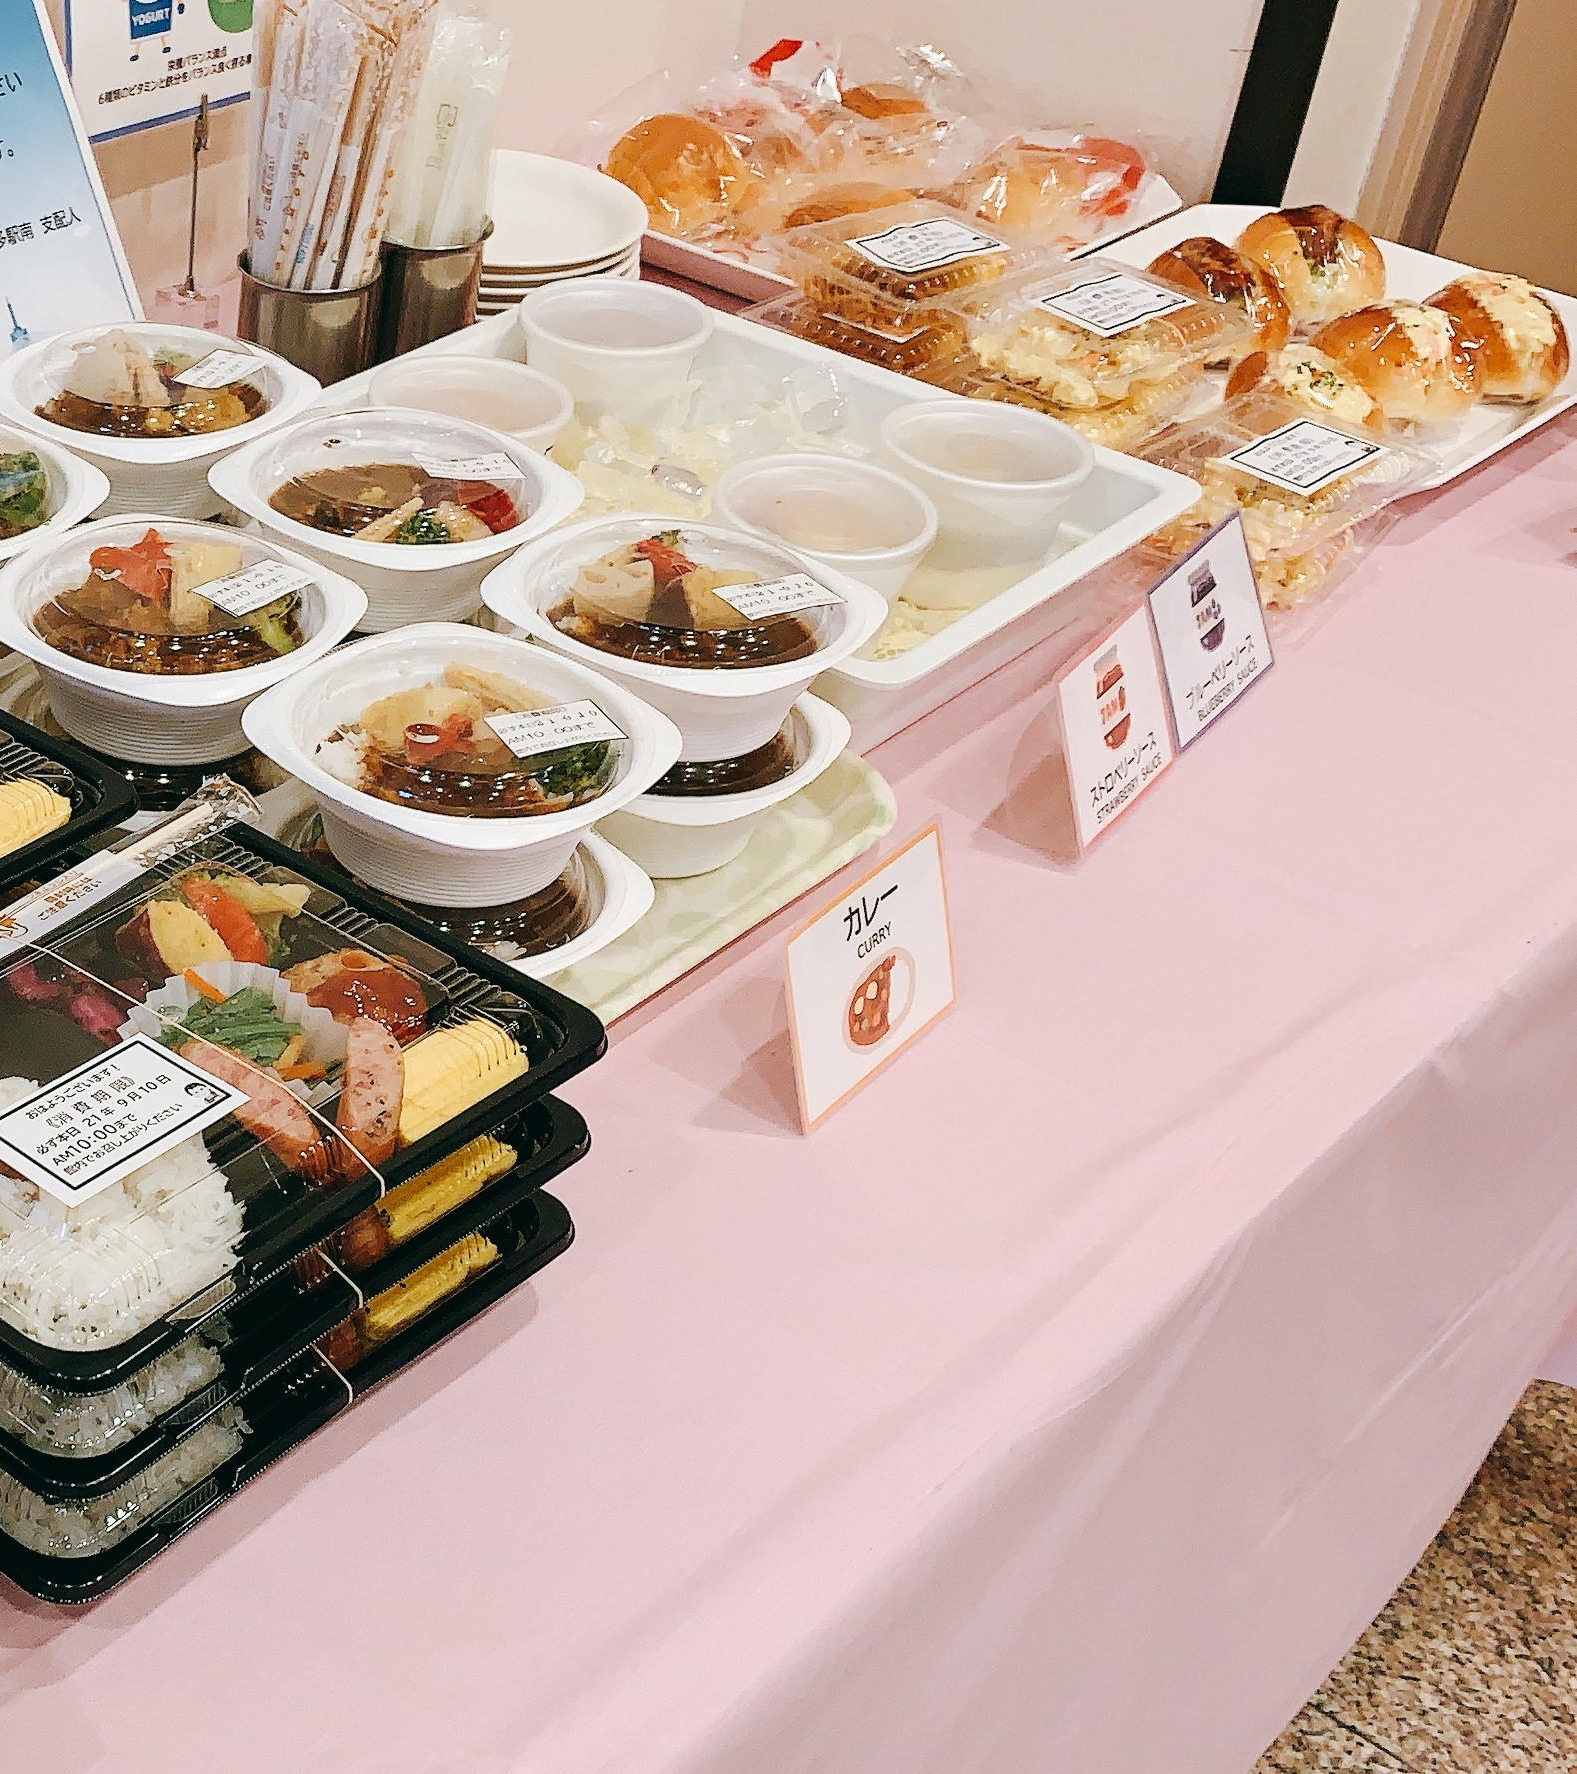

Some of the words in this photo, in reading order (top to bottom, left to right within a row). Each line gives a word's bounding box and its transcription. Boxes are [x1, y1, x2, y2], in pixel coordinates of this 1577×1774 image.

[131, 8, 171, 27] YOGURT
[40, 207, 83, 236] 支配人
[1186, 635, 1255, 711] ブルーベリーソース
[1237, 657, 1259, 689] SAUCE
[1089, 731, 1159, 808] ストロベリーソース
[1096, 776, 1140, 824] STRAWBERRY
[1141, 752, 1164, 784] SAUCE
[843, 884, 898, 942] カレー
[857, 921, 892, 959] CURRY
[52, 1112, 138, 1167] AM10:00まで
[62, 1103, 183, 1176] 館内でお召し上がりください
